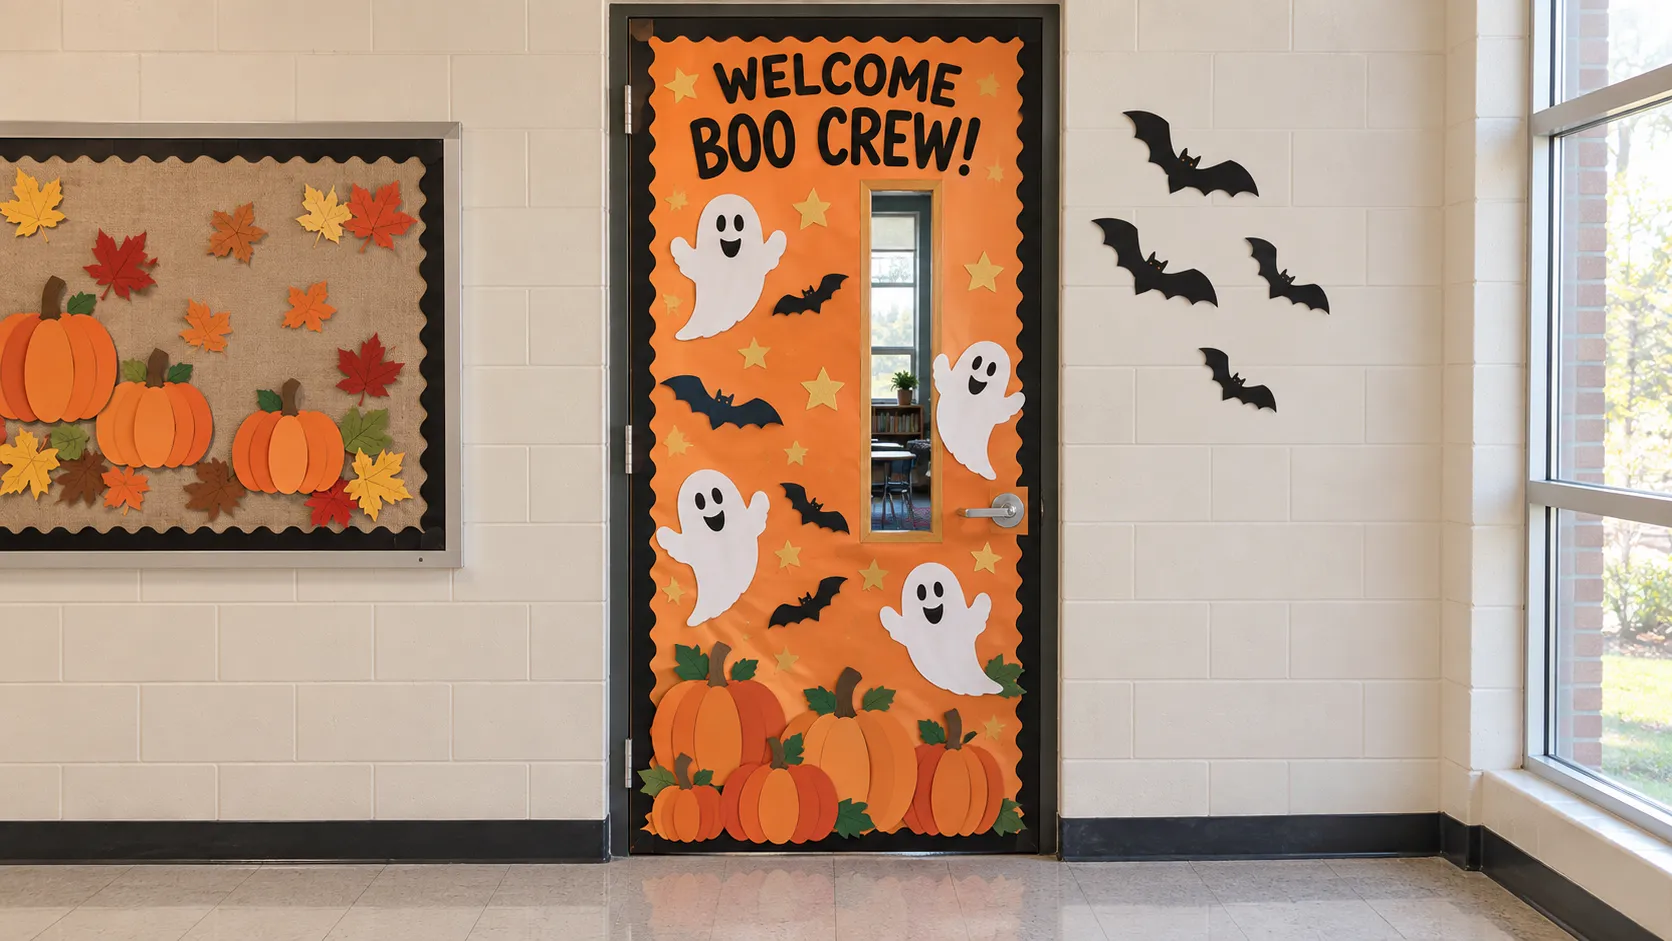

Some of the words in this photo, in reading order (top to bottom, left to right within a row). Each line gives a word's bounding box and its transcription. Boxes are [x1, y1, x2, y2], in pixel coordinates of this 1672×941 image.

[713, 52, 962, 107] WELCOME
[690, 109, 795, 179] BOO
[817, 107, 981, 176] CREW!
